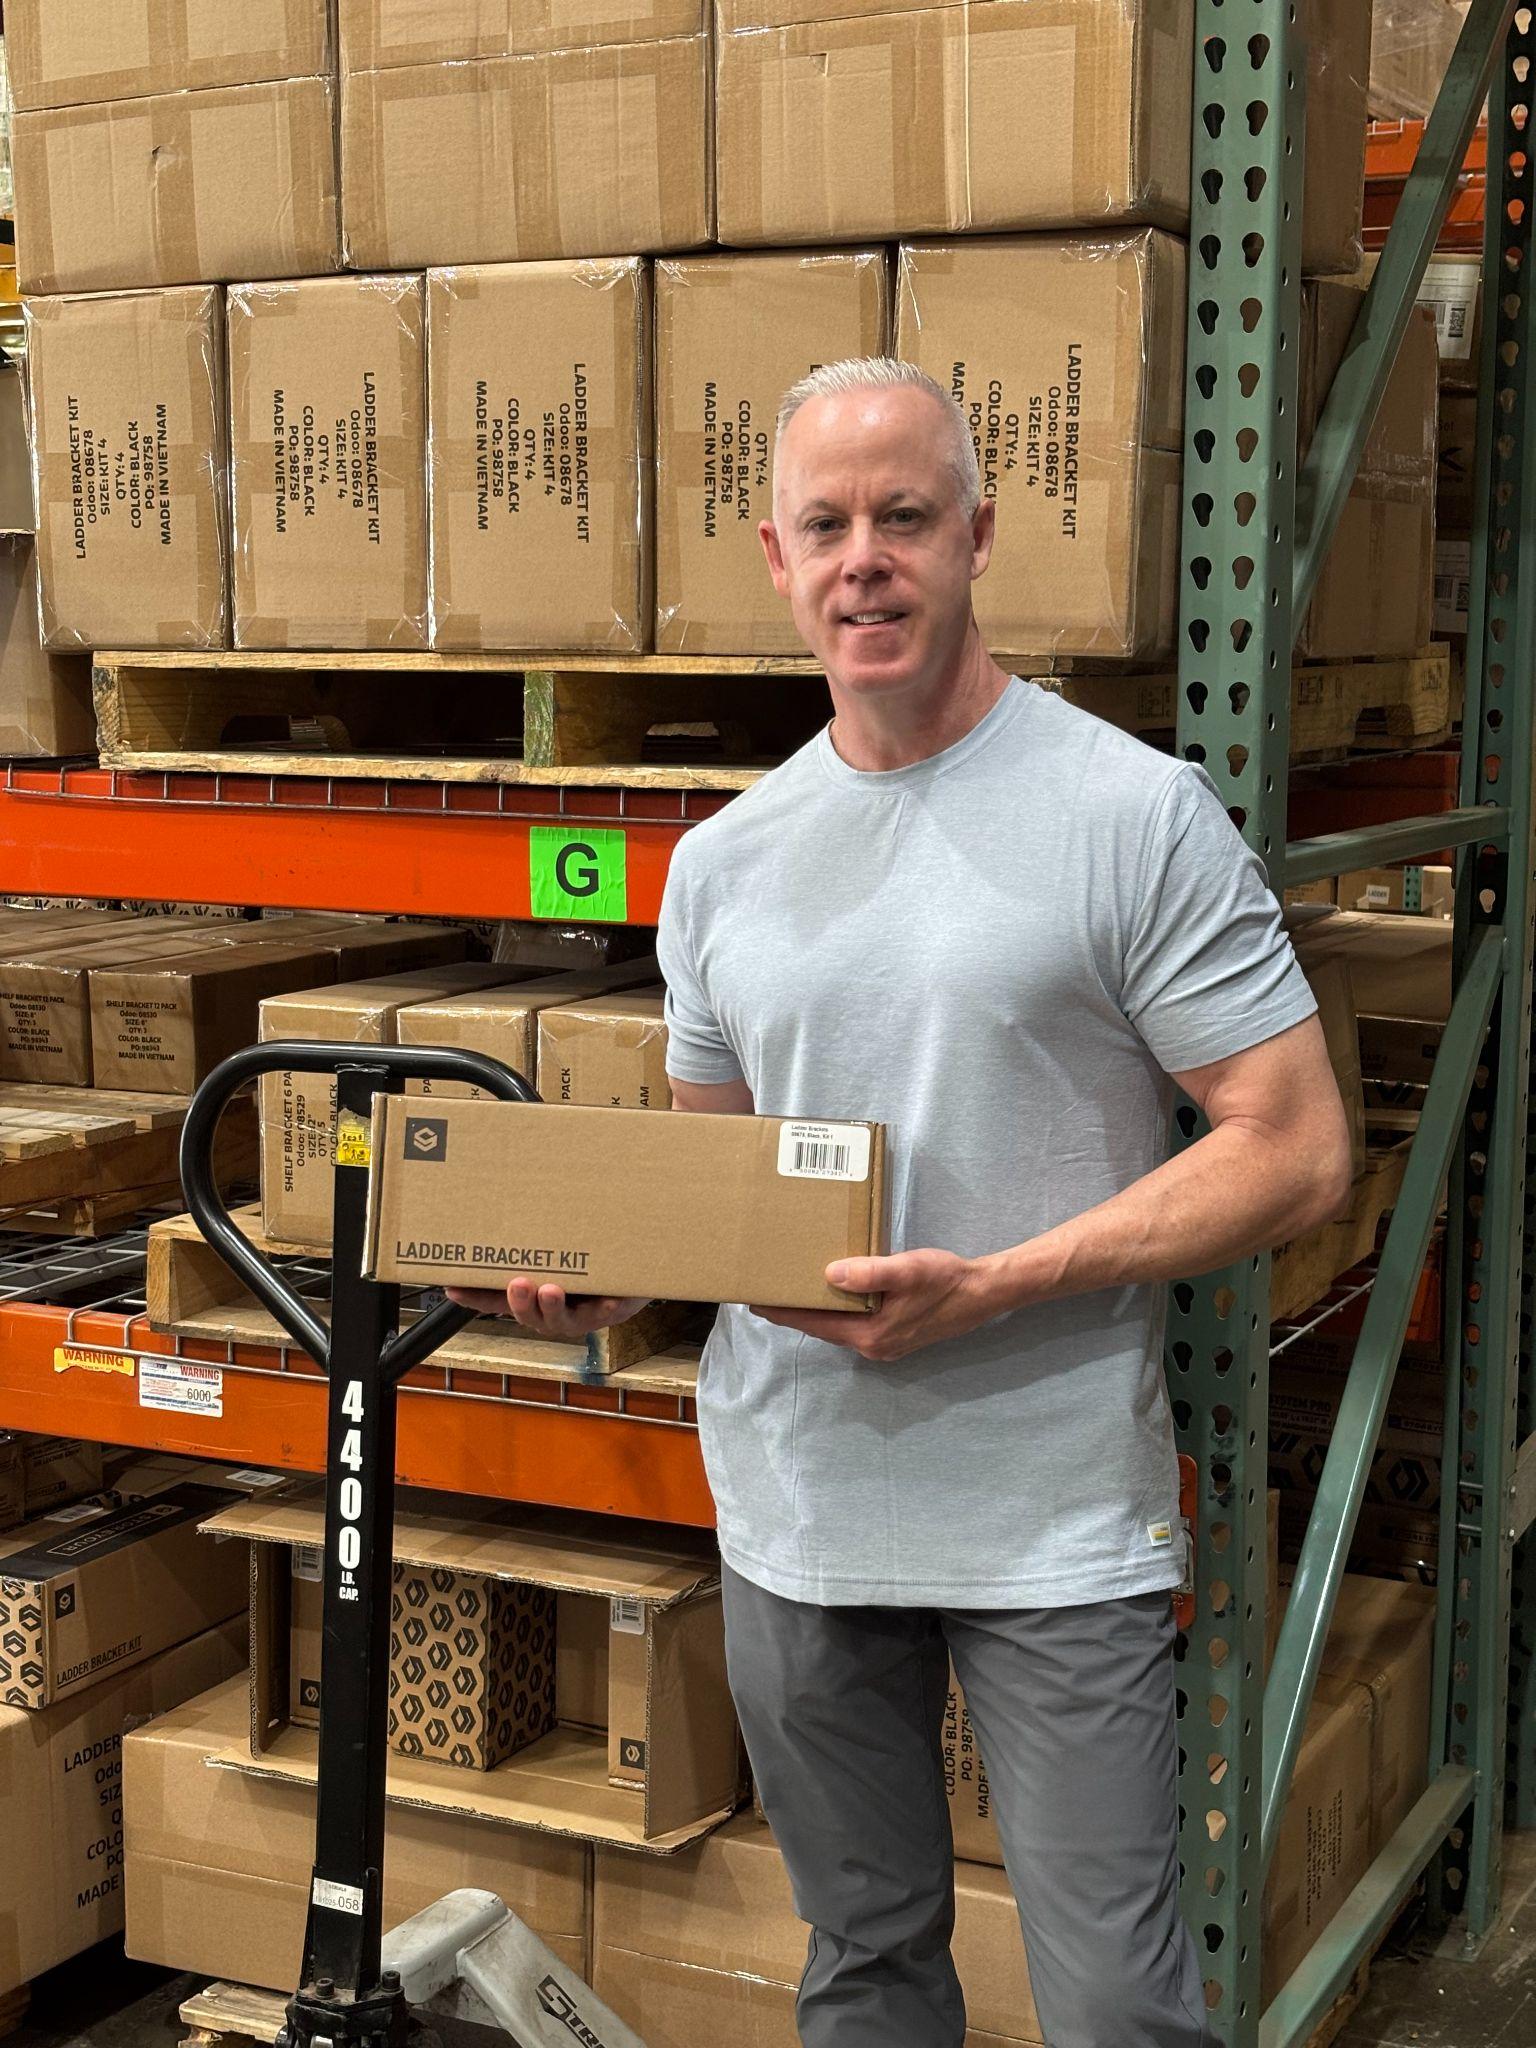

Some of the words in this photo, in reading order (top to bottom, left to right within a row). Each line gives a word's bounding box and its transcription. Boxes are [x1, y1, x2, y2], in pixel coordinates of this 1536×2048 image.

[574, 364, 587, 431] LADDER
[952, 362, 965, 408] MAD
[1066, 344, 1081, 417] LADDER
[68, 395, 78, 420] KIT
[274, 389, 284, 436] MADE
[364, 372, 376, 437] LADDER
[476, 381, 487, 430] MADE
[705, 382, 716, 433] MADE
[987, 380, 1001, 443] COLOR:
[1028, 396, 1042, 438] SIZE:
[1048, 386, 1061, 437] Odoo:
[98, 438, 107, 448] 4
[156, 404, 168, 473] VIETNAM
[289, 426, 298, 450] PO:
[303, 405, 314, 461] COLOR:
[336, 419, 346, 456] SIZE:
[351, 410, 361, 454] Odoo:
[477, 434, 487, 451] IN
[492, 419, 502, 445] PO:
[508, 398, 519, 457] COLOR:
[544, 412, 554, 451] SIZE:
[560, 403, 571, 450] Odoo:
[722, 422, 733, 449] PO:
[738, 400, 750, 462] COLOR:
[1005, 414, 1019, 454] QTY:
[70, 424, 82, 494] BRACKET
[84, 429, 95, 477] 08678
[98, 452, 109, 475] KIT
[115, 452, 124, 462] 4
[128, 421, 140, 470] BLACK
[143, 436, 154, 481] 98758
[275, 440, 284, 456] IN
[318, 435, 328, 471] QTY:
[523, 429, 535, 466] QTY:
[705, 438, 716, 455] IN
[755, 433, 767, 471] QTY:
[1005, 458, 1018, 470] 4
[1027, 442, 1039, 471] KIT
[1063, 422, 1079, 505] BRACKET
[115, 465, 127, 500] QTY:
[290, 455, 300, 500] 98758
[319, 474, 329, 484] 4
[336, 460, 347, 485] KIT
[352, 458, 363, 508] 08678
[366, 441, 379, 514] BRACKET
[493, 449, 503, 497] 98758
[525, 469, 536, 480] 4
[544, 455, 555, 481] KIT
[560, 454, 572, 505] 08678
[576, 436, 588, 512] BRACKET
[721, 453, 733, 503] 98758
[756, 475, 767, 486] 4
[1027, 475, 1039, 487] 4
[1045, 442, 1060, 497] 08678
[87, 481, 96, 523] Odoo:
[100, 479, 110, 515] SIZE:
[130, 474, 141, 528] COLOR:
[145, 485, 154, 509] PO:
[159, 479, 169, 495] IN
[275, 460, 286, 532] VIETNAM
[303, 465, 315, 516] BLACK
[338, 488, 347, 499] 4
[477, 455, 488, 530] VIETNAM
[508, 461, 519, 513] BLACK
[545, 485, 555, 496] 4
[705, 459, 716, 537] VIETNAM
[738, 465, 750, 520] BLACK
[73, 498, 85, 559] LADDER
[160, 500, 171, 544] MADE
[368, 518, 380, 544] KIT
[577, 516, 589, 543] KIT
[1063, 509, 1076, 539] KIT
[556, 843, 599, 897] G
[284, 1072, 292, 1086] PA
[285, 1089, 292, 1097] 6
[562, 1068, 571, 1100] PACK
[284, 1100, 292, 1153] BRACKET
[297, 1134, 305, 1166] Odoo:
[285, 1156, 293, 1192] SHELF
[397, 1241, 466, 1261] LADDER
[472, 1246, 554, 1267] BRACKET
[560, 1251, 589, 1269] KIT
[63, 1349, 124, 1367] WARNING
[180, 1365, 219, 1380] WARNING
[187, 1388, 211, 1402] 6000
[339, 1586, 358, 1601] CAP.
[341, 1570, 355, 1585] LB.
[57, 1661, 89, 1685] LADDER
[91, 1642, 127, 1669] BRACKET
[129, 1635, 142, 1650] KIT
[64, 1734, 120, 1773] LADDER
[962, 1756, 973, 1781] PO:
[95, 1761, 122, 1784] Odo
[100, 1783, 122, 1806] SIZ
[88, 1831, 123, 1859] COLO
[78, 1874, 119, 1908] MADE
